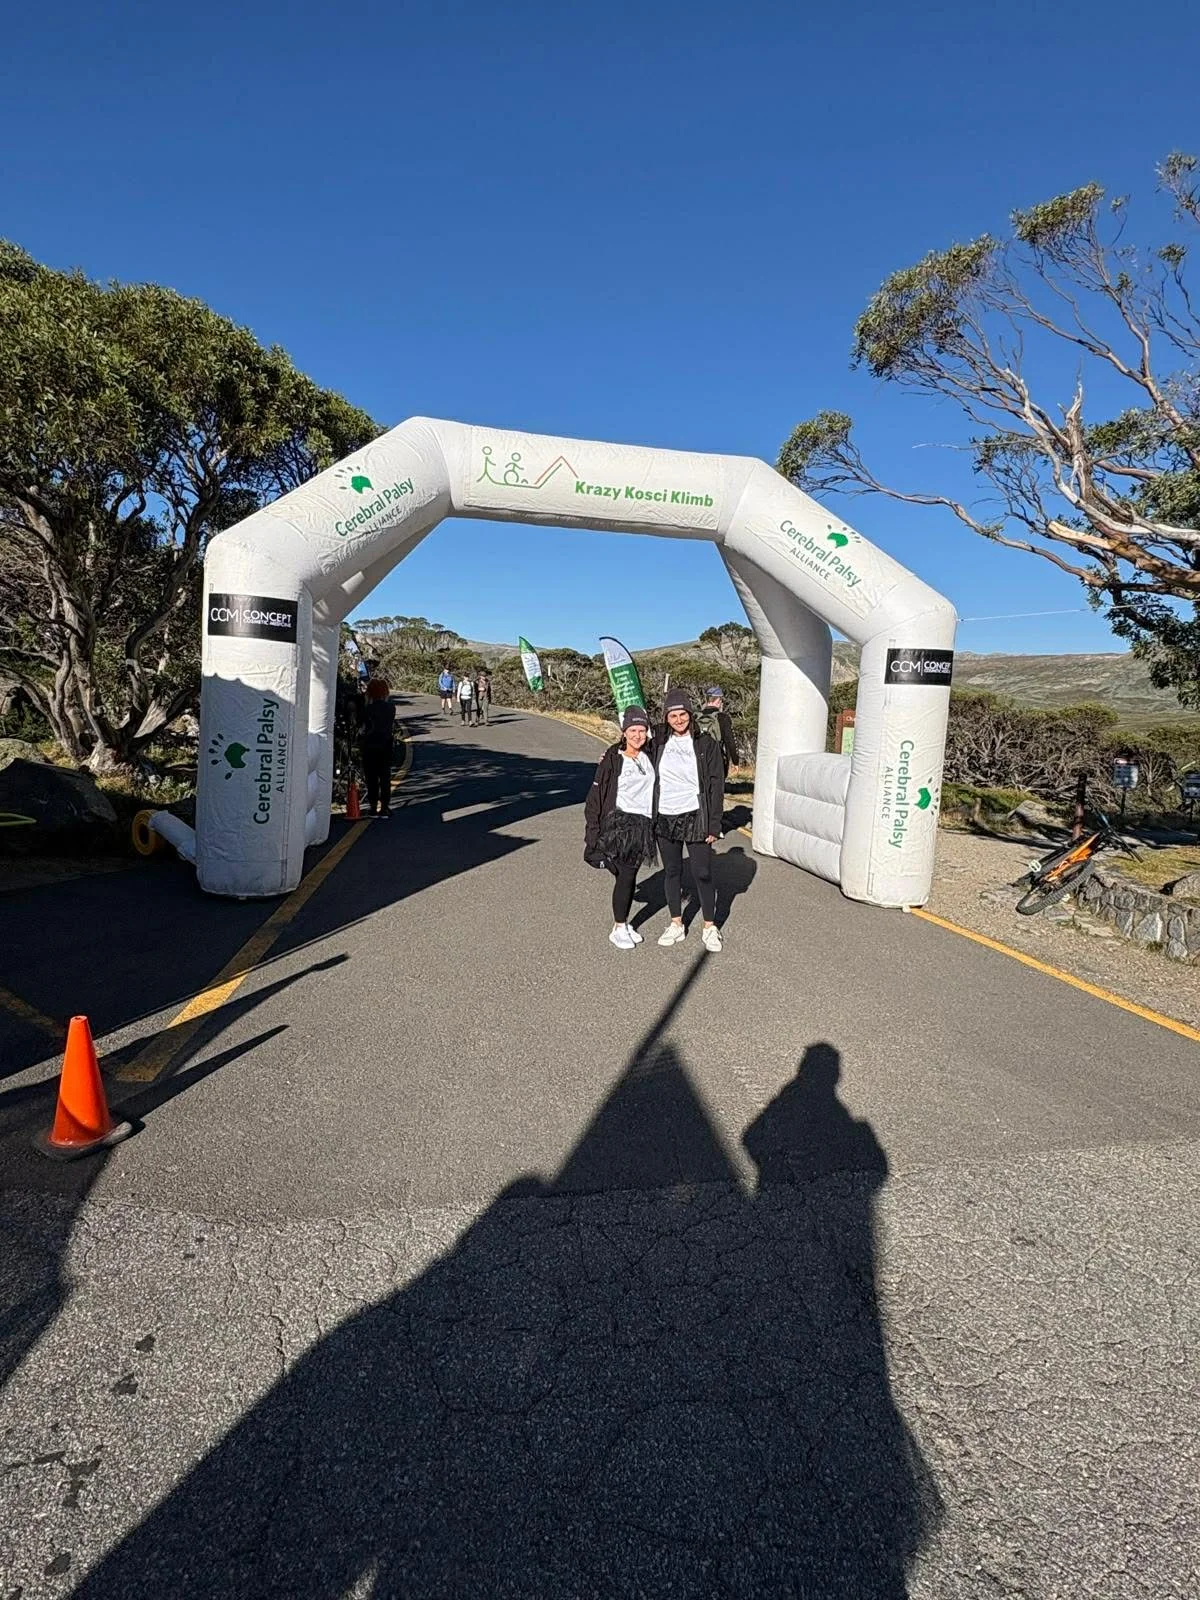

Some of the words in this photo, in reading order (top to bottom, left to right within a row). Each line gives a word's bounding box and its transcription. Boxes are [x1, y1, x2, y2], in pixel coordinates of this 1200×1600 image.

[335, 494, 387, 537] Cerebral
[383, 477, 414, 504] Palsy
[575, 481, 621, 501] Krazy
[624, 486, 667, 502] Kosci
[671, 490, 713, 507] Klimb
[780, 520, 832, 562] Cerebral
[828, 555, 862, 588] Palsy
[790, 547, 831, 581] ALLIANCE
[210, 607, 239, 623] CCM
[242, 609, 293, 623] CONCEPT
[890, 660, 921, 673] CCM
[256, 698, 280, 745] Palsy
[253, 748, 273, 825] Cerebral
[276, 732, 288, 793] ALLIANCE
[895, 739, 915, 806] Cerebral
[881, 766, 894, 820] ALLIANCE
[888, 809, 909, 849] Palsy
